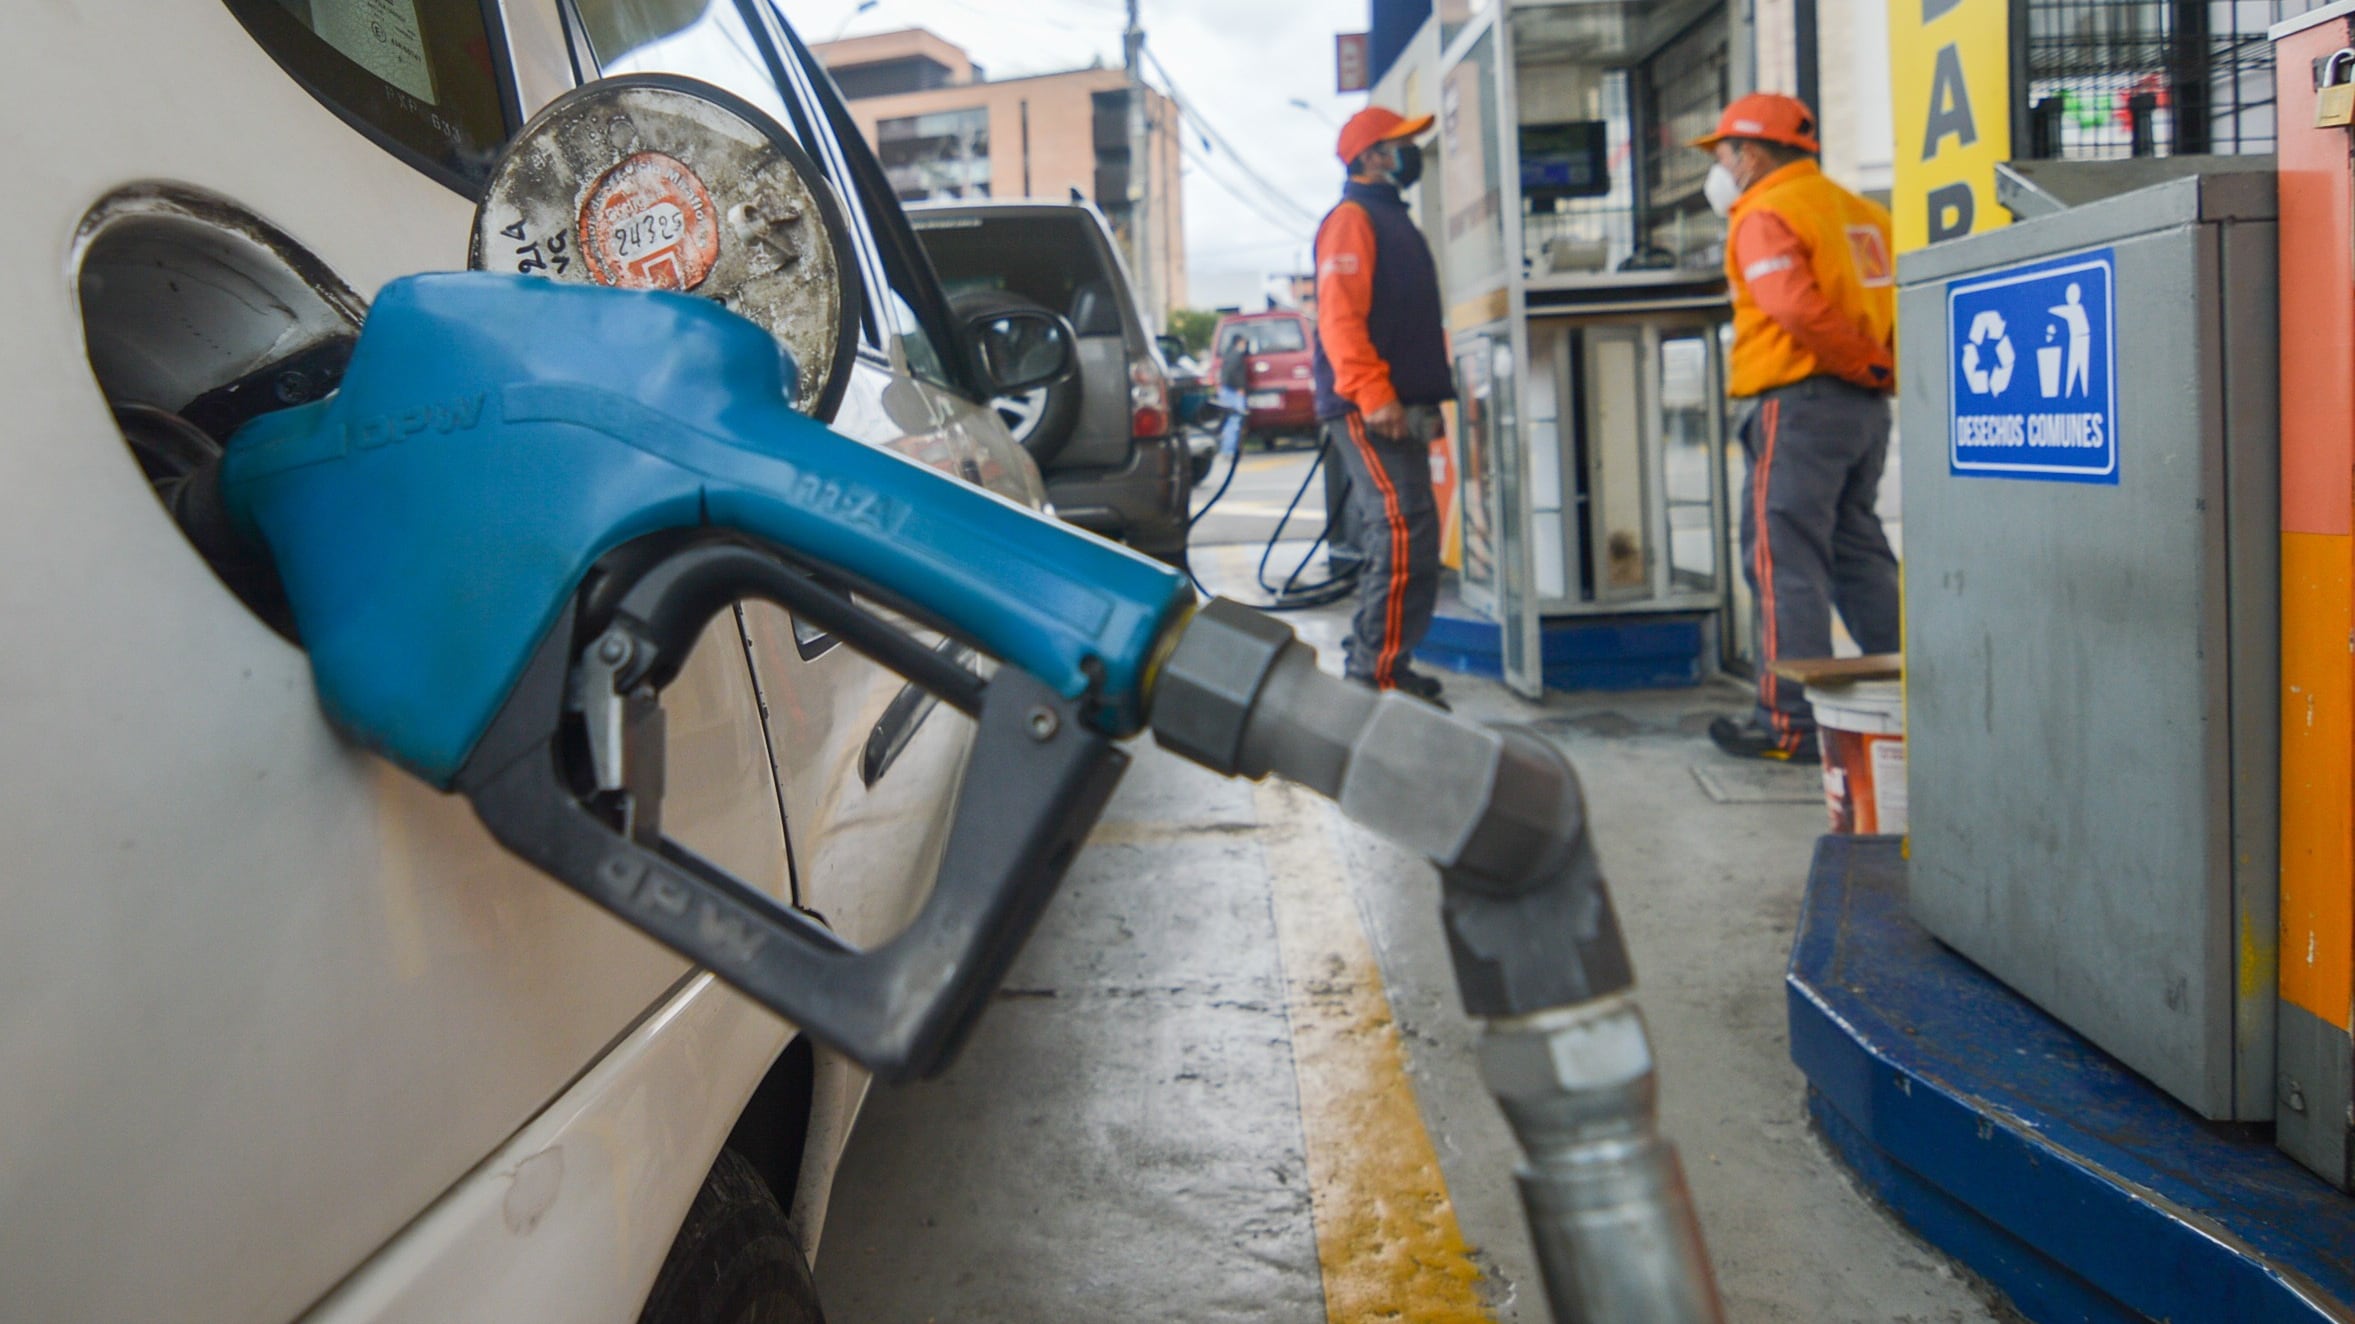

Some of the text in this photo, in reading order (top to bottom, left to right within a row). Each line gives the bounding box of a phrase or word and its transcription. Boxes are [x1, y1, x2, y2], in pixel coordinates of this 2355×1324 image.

[614, 211, 682, 257] 24325
[1957, 412, 2104, 448] DESECHOS COMUNES
[598, 850, 768, 962] OPW
